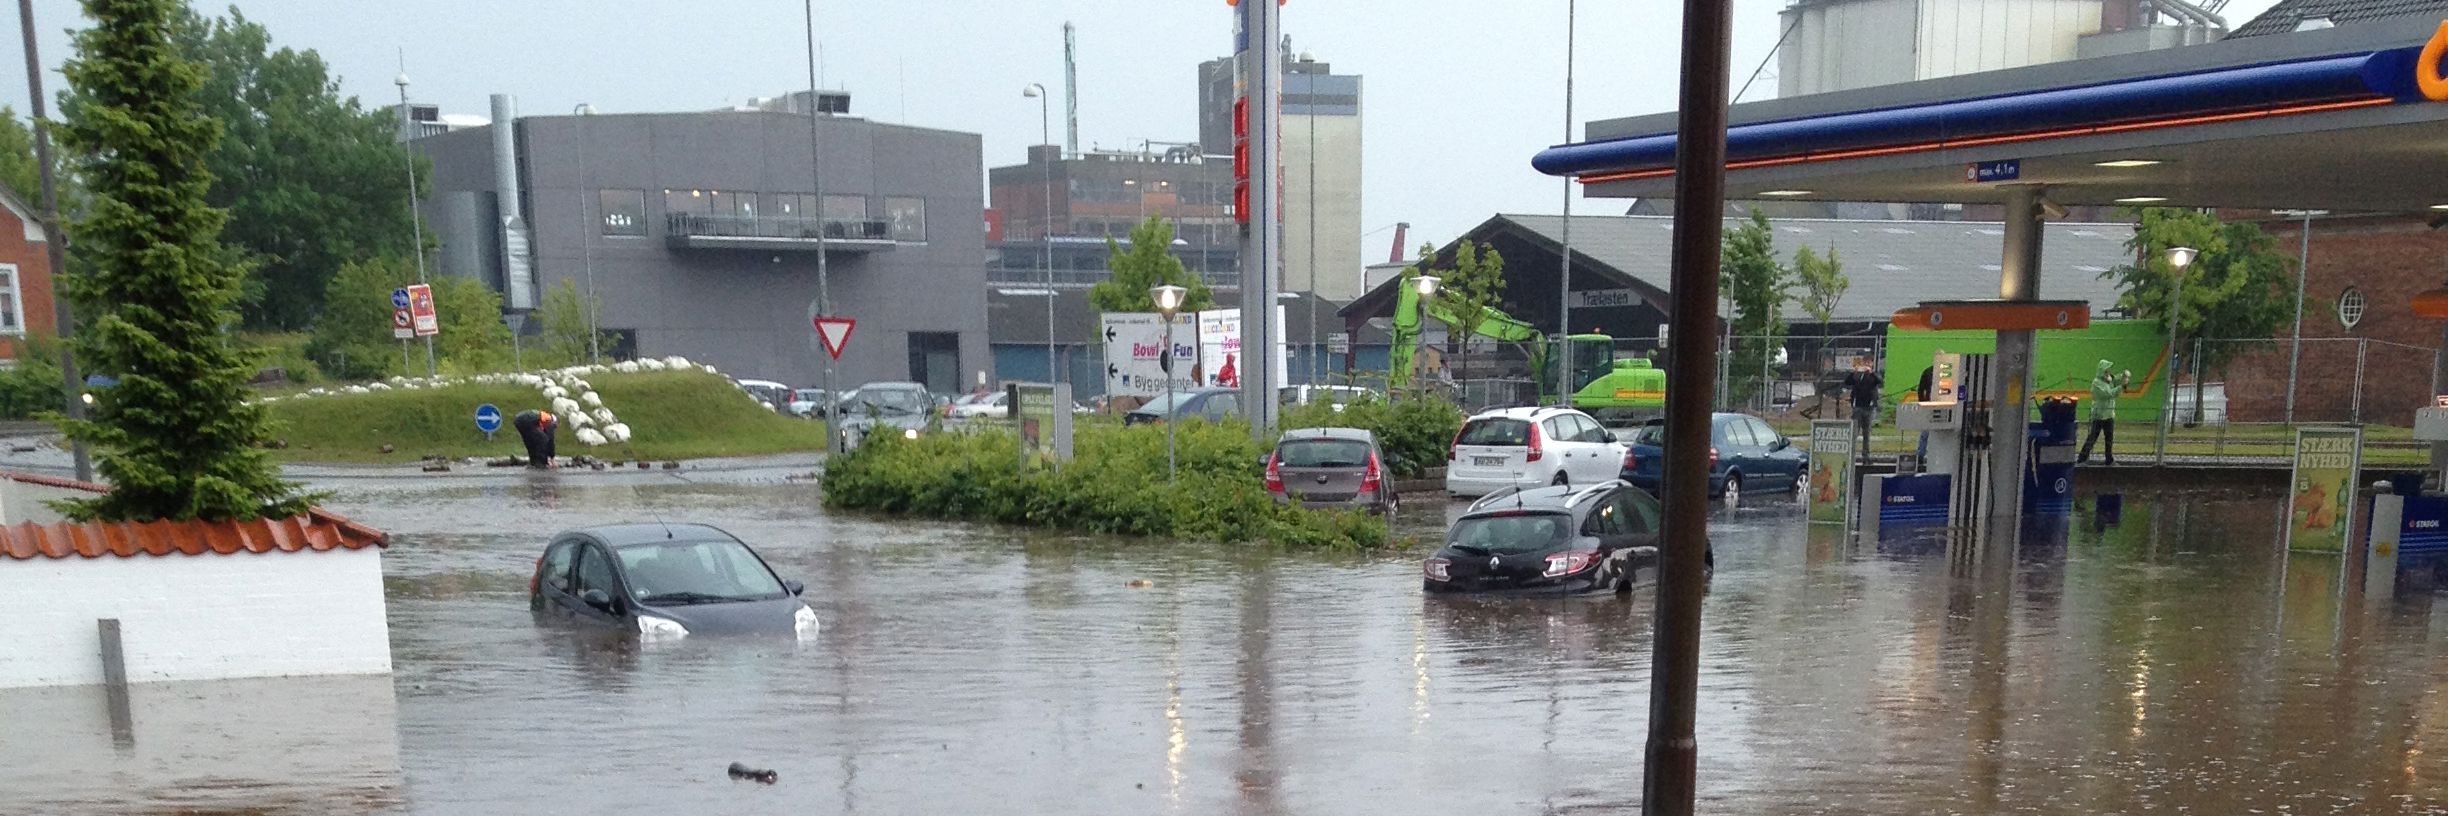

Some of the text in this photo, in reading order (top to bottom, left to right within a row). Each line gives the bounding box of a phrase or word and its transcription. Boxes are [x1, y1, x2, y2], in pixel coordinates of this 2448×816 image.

[1133, 342, 1159, 357] Bowl
[1173, 343, 1193, 357] Fun
[1816, 427, 1850, 440] STÆRK
[1815, 441, 1849, 453] NYHED
[2301, 438, 2352, 453] STÆRK
[2299, 453, 2351, 468] NYHED
